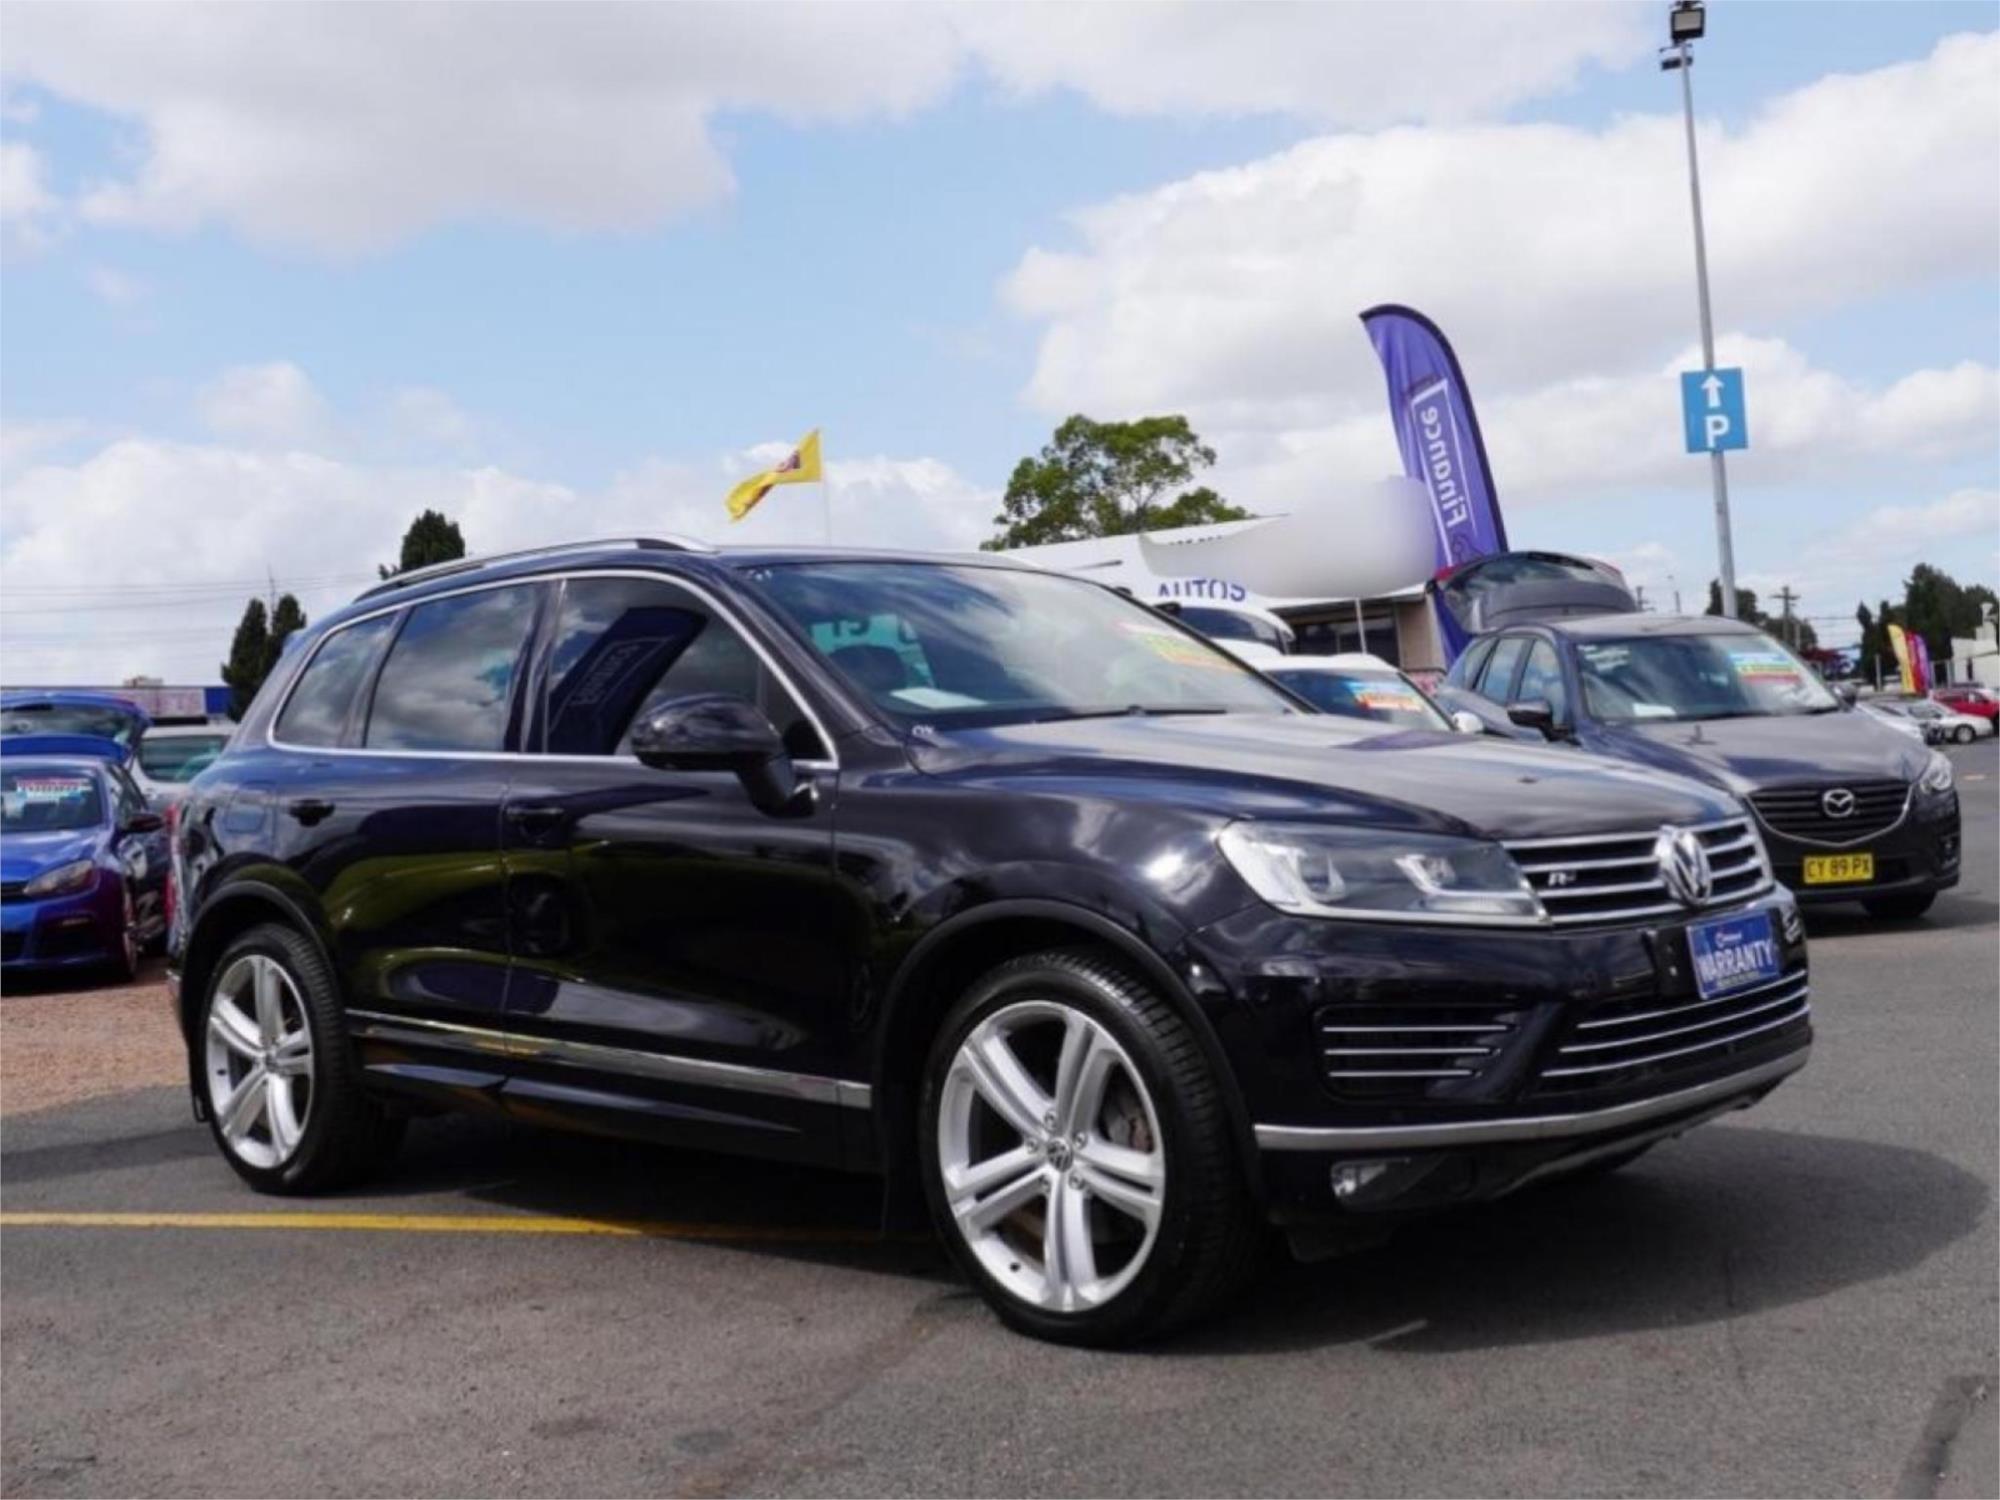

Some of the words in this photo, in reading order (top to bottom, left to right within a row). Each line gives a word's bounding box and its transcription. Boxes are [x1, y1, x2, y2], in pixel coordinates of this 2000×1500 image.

[1705, 415, 1729, 448] P
[1806, 860, 1825, 878] CY
[1697, 938, 1774, 982] WARRANTY
